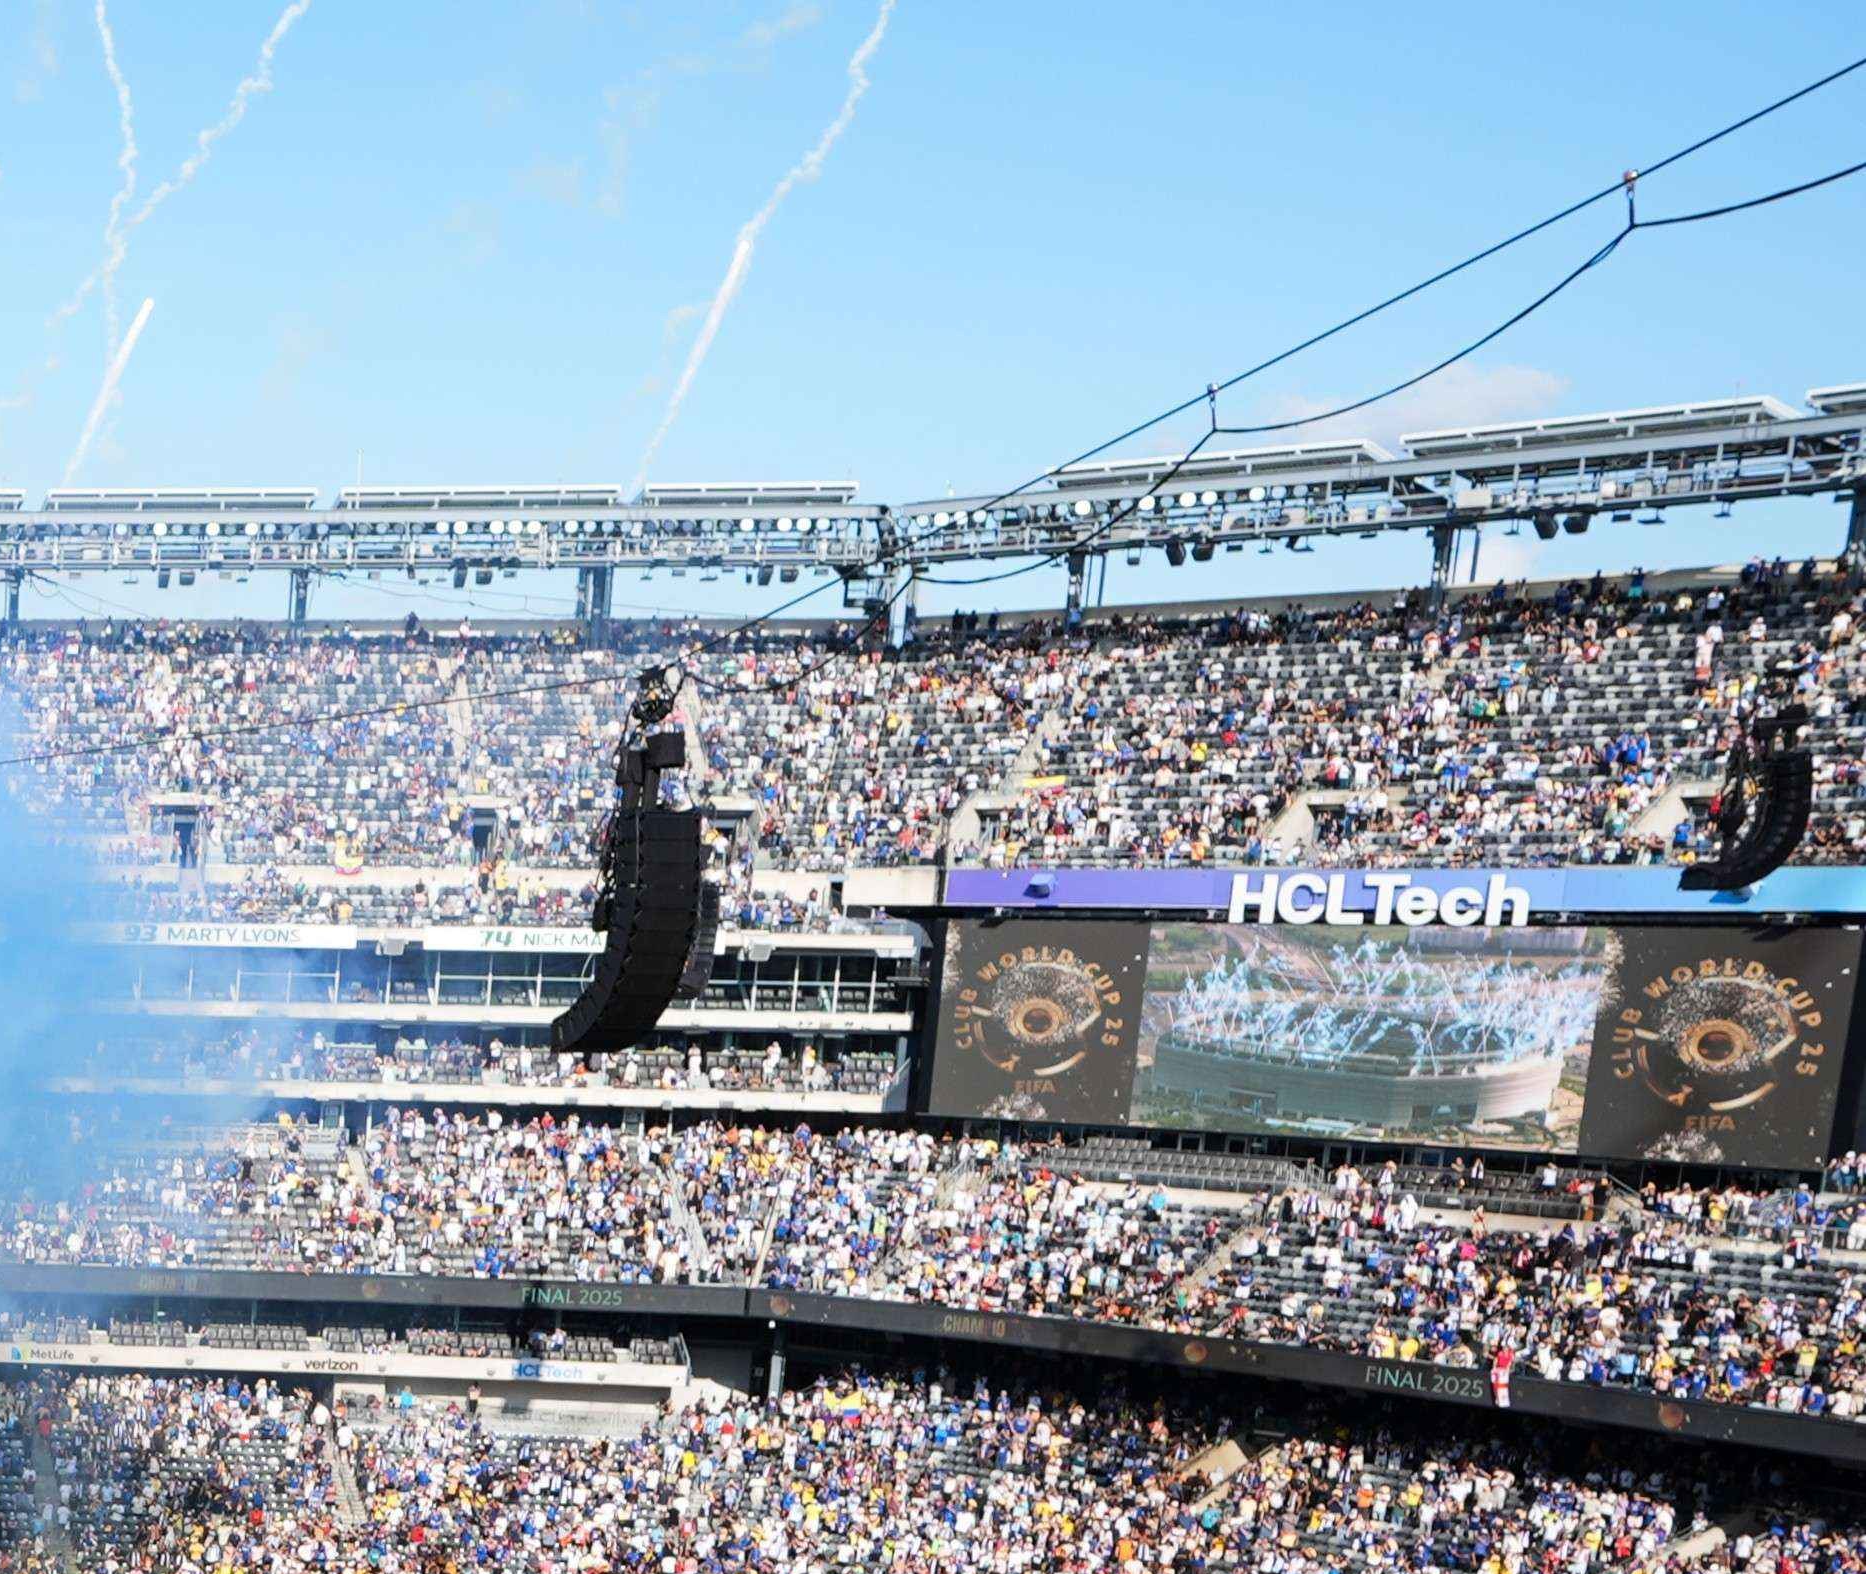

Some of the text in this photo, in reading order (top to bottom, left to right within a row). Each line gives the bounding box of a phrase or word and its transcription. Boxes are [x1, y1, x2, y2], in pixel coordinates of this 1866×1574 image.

[1227, 873, 1530, 927] HCLTech
[166, 926, 238, 943] MARTY
[242, 926, 302, 944] LYONS
[479, 930, 513, 947] 74
[523, 933, 565, 947] NICK
[521, 1287, 623, 1306] FINAL 2025
[30, 1348, 75, 1361] MetLife
[304, 1357, 359, 1372] verizon
[1364, 1365, 1485, 1399] FINAL 2025
